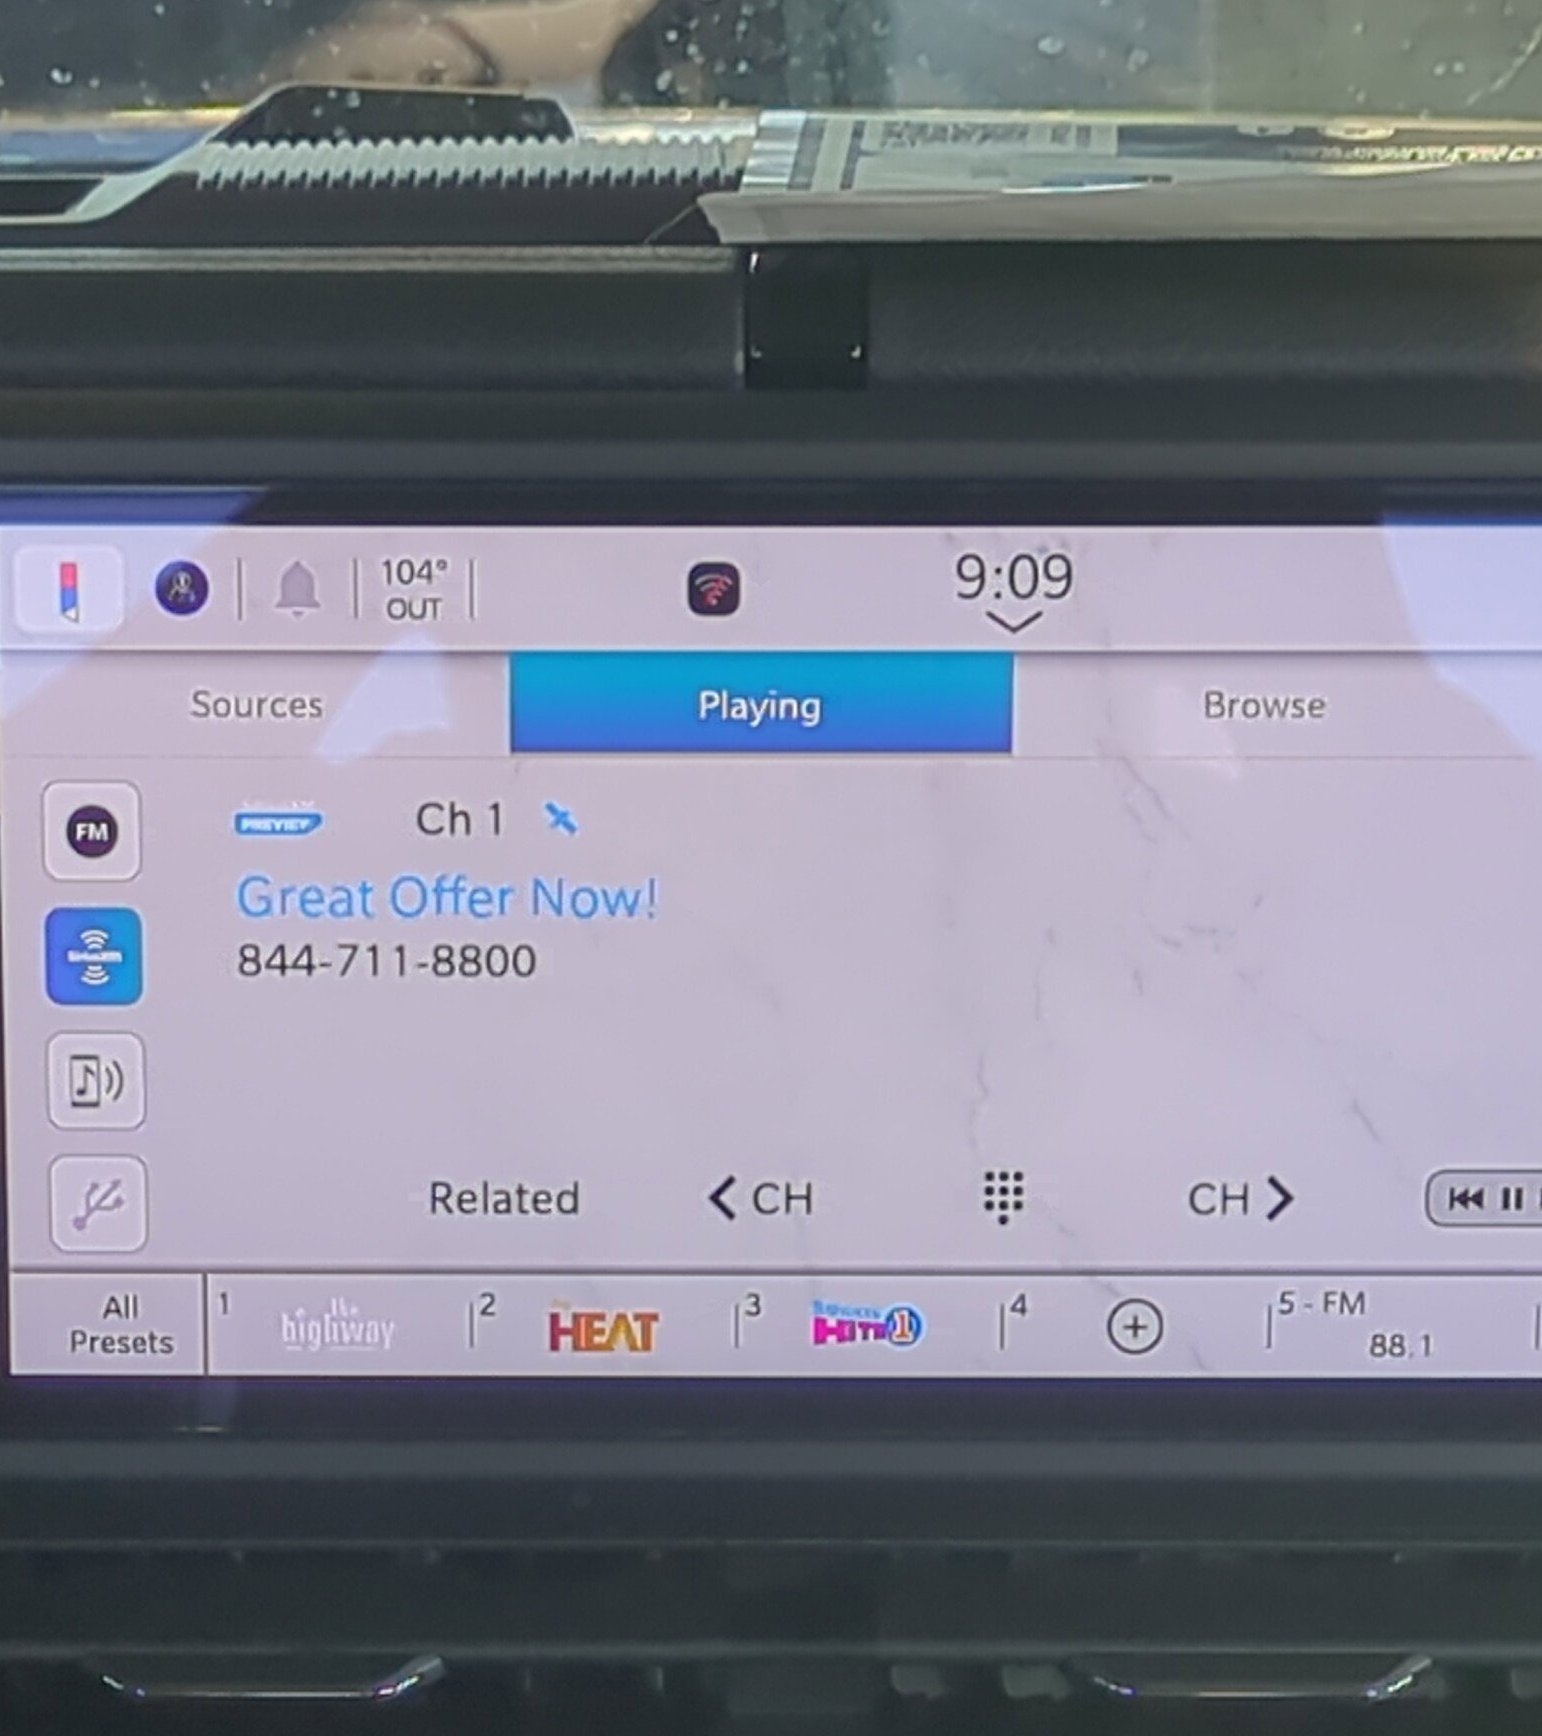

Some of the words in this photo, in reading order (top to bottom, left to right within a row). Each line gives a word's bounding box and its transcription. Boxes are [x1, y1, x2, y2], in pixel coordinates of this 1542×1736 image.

[954, 551, 1074, 601] 9:09
[386, 597, 443, 622] OUT
[189, 688, 324, 719] Sources
[698, 688, 823, 728] Playing
[1203, 689, 1327, 719] Browse
[75, 822, 111, 843] FM
[415, 799, 473, 838] Ch
[488, 801, 503, 837] 1
[237, 874, 375, 919] Great
[389, 874, 515, 919] Offer
[532, 877, 659, 919] Now!
[236, 943, 538, 978] 844-711-8800
[428, 1179, 581, 1217] Related
[751, 1181, 814, 1217] CH
[1187, 1181, 1250, 1217] CH
[102, 1294, 140, 1320] All
[218, 1292, 231, 1316] 1
[479, 1292, 497, 1317] 2
[744, 1292, 763, 1317] 3
[1010, 1292, 1028, 1317] 4
[1278, 1291, 1295, 1315] 5
[1321, 1291, 1367, 1315] FM
[69, 1330, 175, 1356] Presets
[549, 1311, 660, 1353] HEAT
[1368, 1334, 1434, 1359] 88.1
